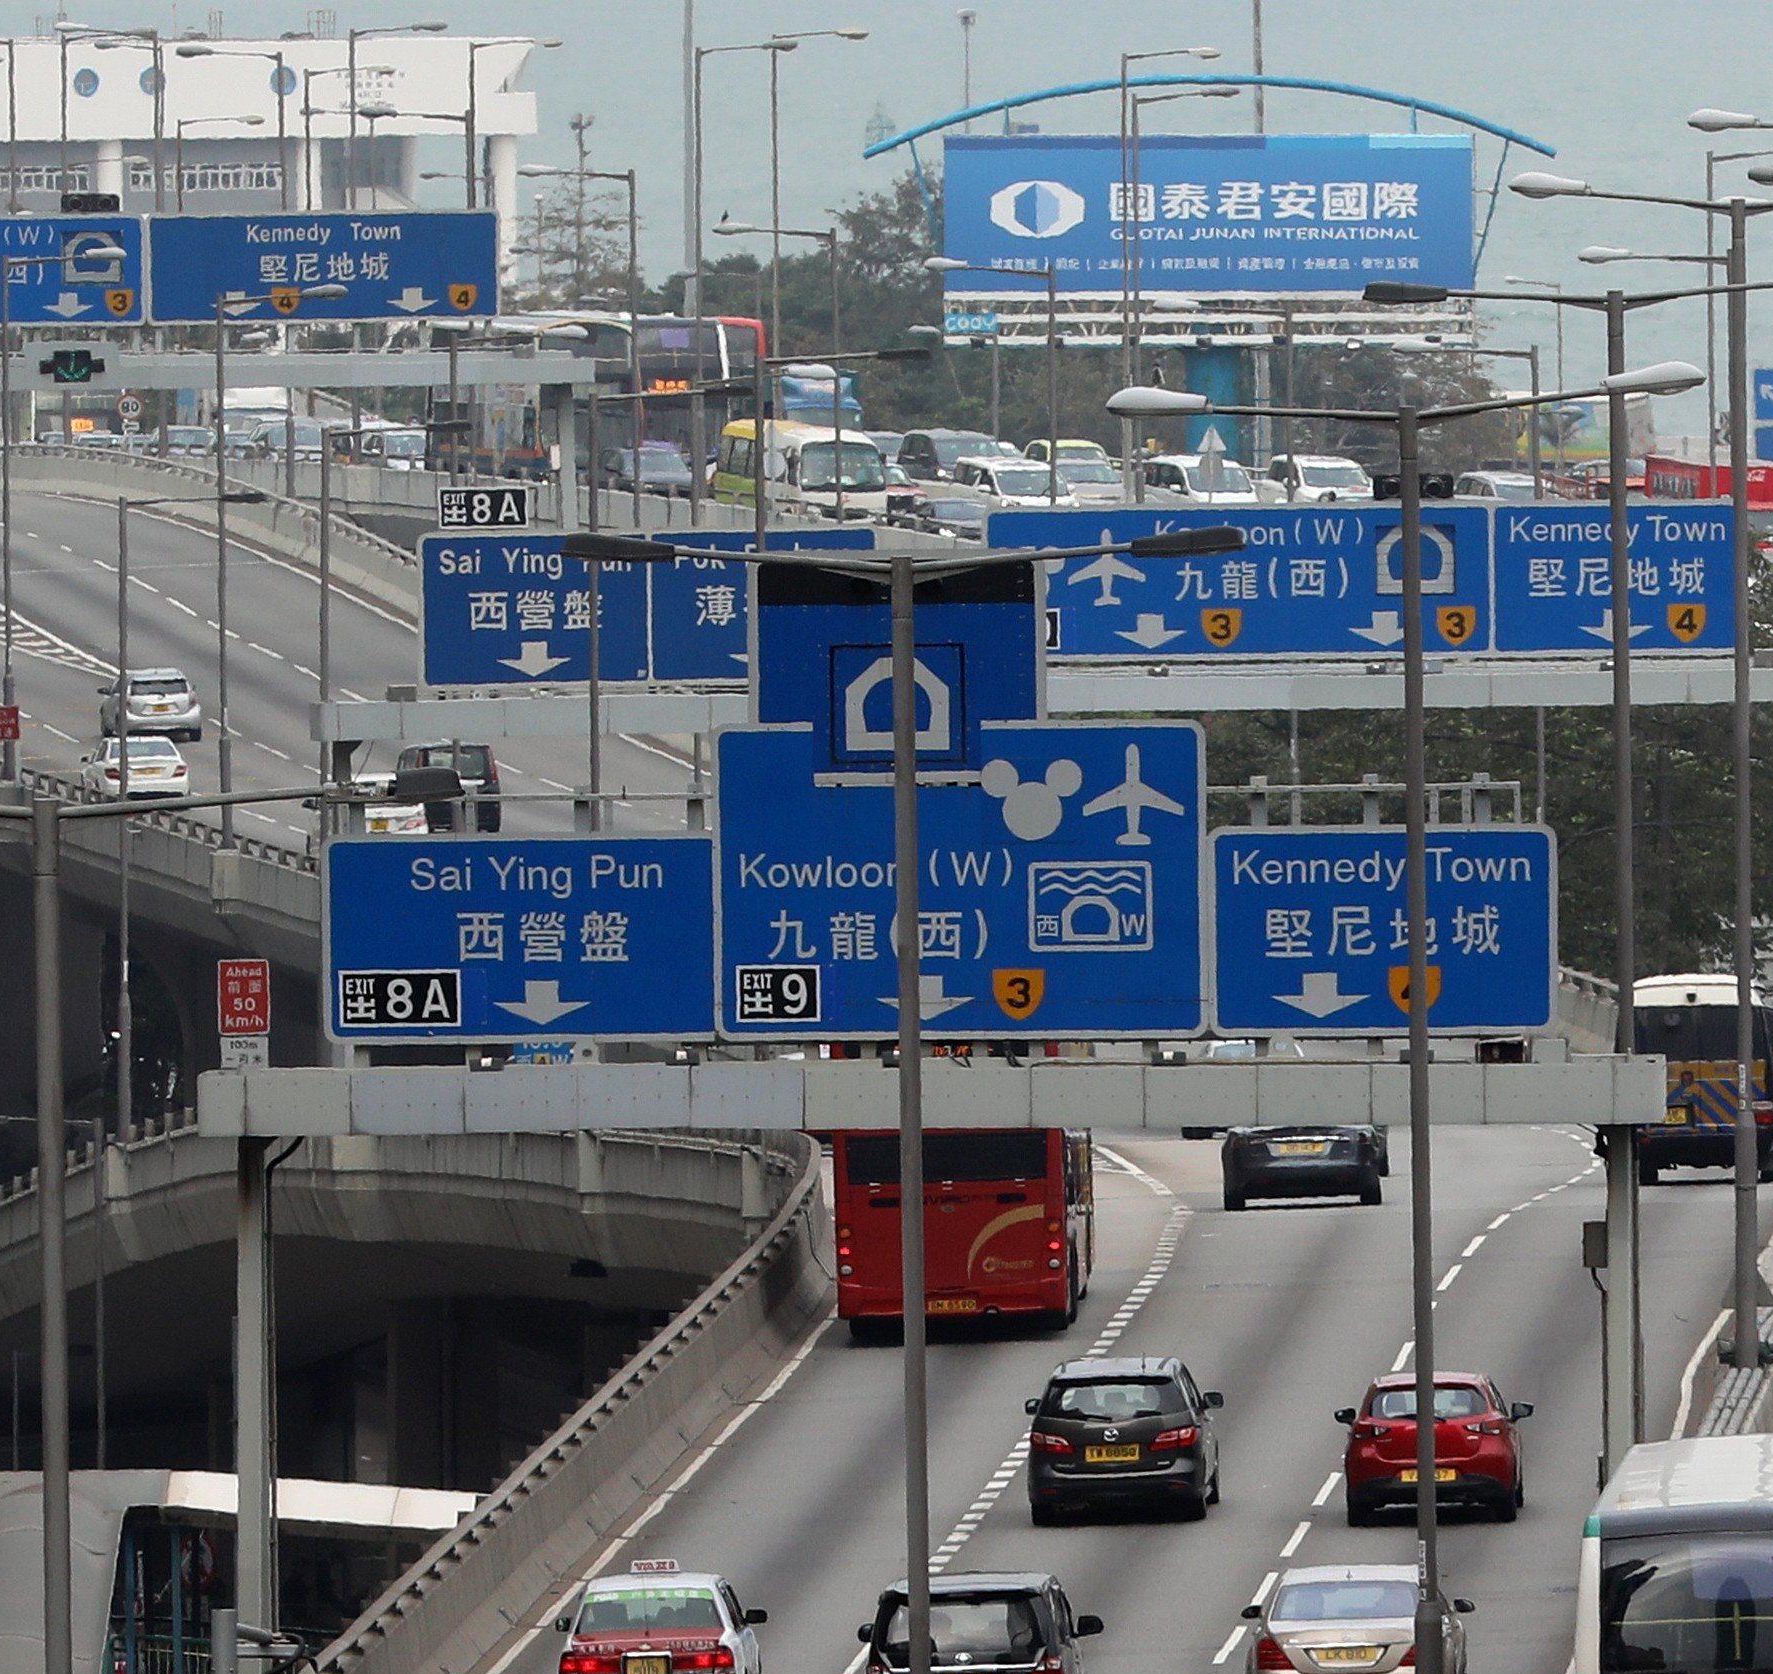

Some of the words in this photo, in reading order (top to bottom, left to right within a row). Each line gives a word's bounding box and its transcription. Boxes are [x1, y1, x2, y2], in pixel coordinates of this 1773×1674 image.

[1109, 181, 1420, 222] 國泰君安國際
[246, 224, 331, 246] Kennedy
[350, 222, 401, 241] Town
[1188, 227, 1255, 241] JUNAN
[1263, 226, 1420, 241] INTERNATIONAL
[259, 252, 390, 283] 堅尼地城
[111, 293, 127, 312] 3
[456, 289, 469, 307] 4
[443, 493, 467, 505] EXIT
[443, 505, 467, 524] 出
[1646, 514, 1727, 542] Town
[438, 547, 481, 575] Sai
[502, 546, 563, 580] Ying
[1528, 555, 1706, 597] 堅尼地城
[1174, 557, 1349, 601] 九龍(西)
[468, 589, 604, 631] 西營盤
[1675, 608, 1698, 634] 4
[1210, 613, 1232, 640] 3
[1446, 612, 1466, 639] 3
[410, 857, 472, 892] Sai
[487, 855, 573, 899] Ying
[590, 854, 663, 889] Pun
[1232, 849, 1406, 892] Kennedy
[1425, 846, 1532, 883] Town
[456, 909, 629, 963] 西營盤
[1035, 915, 1059, 937] 西
[1121, 914, 1145, 937] W
[1264, 904, 1501, 959] 堅尼地城
[225, 966, 262, 977] Ahead
[743, 973, 773, 990] EXIT
[345, 978, 376, 995] EXIT
[386, 977, 451, 1020] 8A
[782, 973, 808, 1014] 9
[1006, 977, 1032, 1009] 3
[233, 998, 256, 1012] 50
[346, 997, 376, 1020] 出
[743, 991, 773, 1014] 出
[225, 1014, 264, 1028] km/h
[634, 1561, 676, 1570] TAXI
